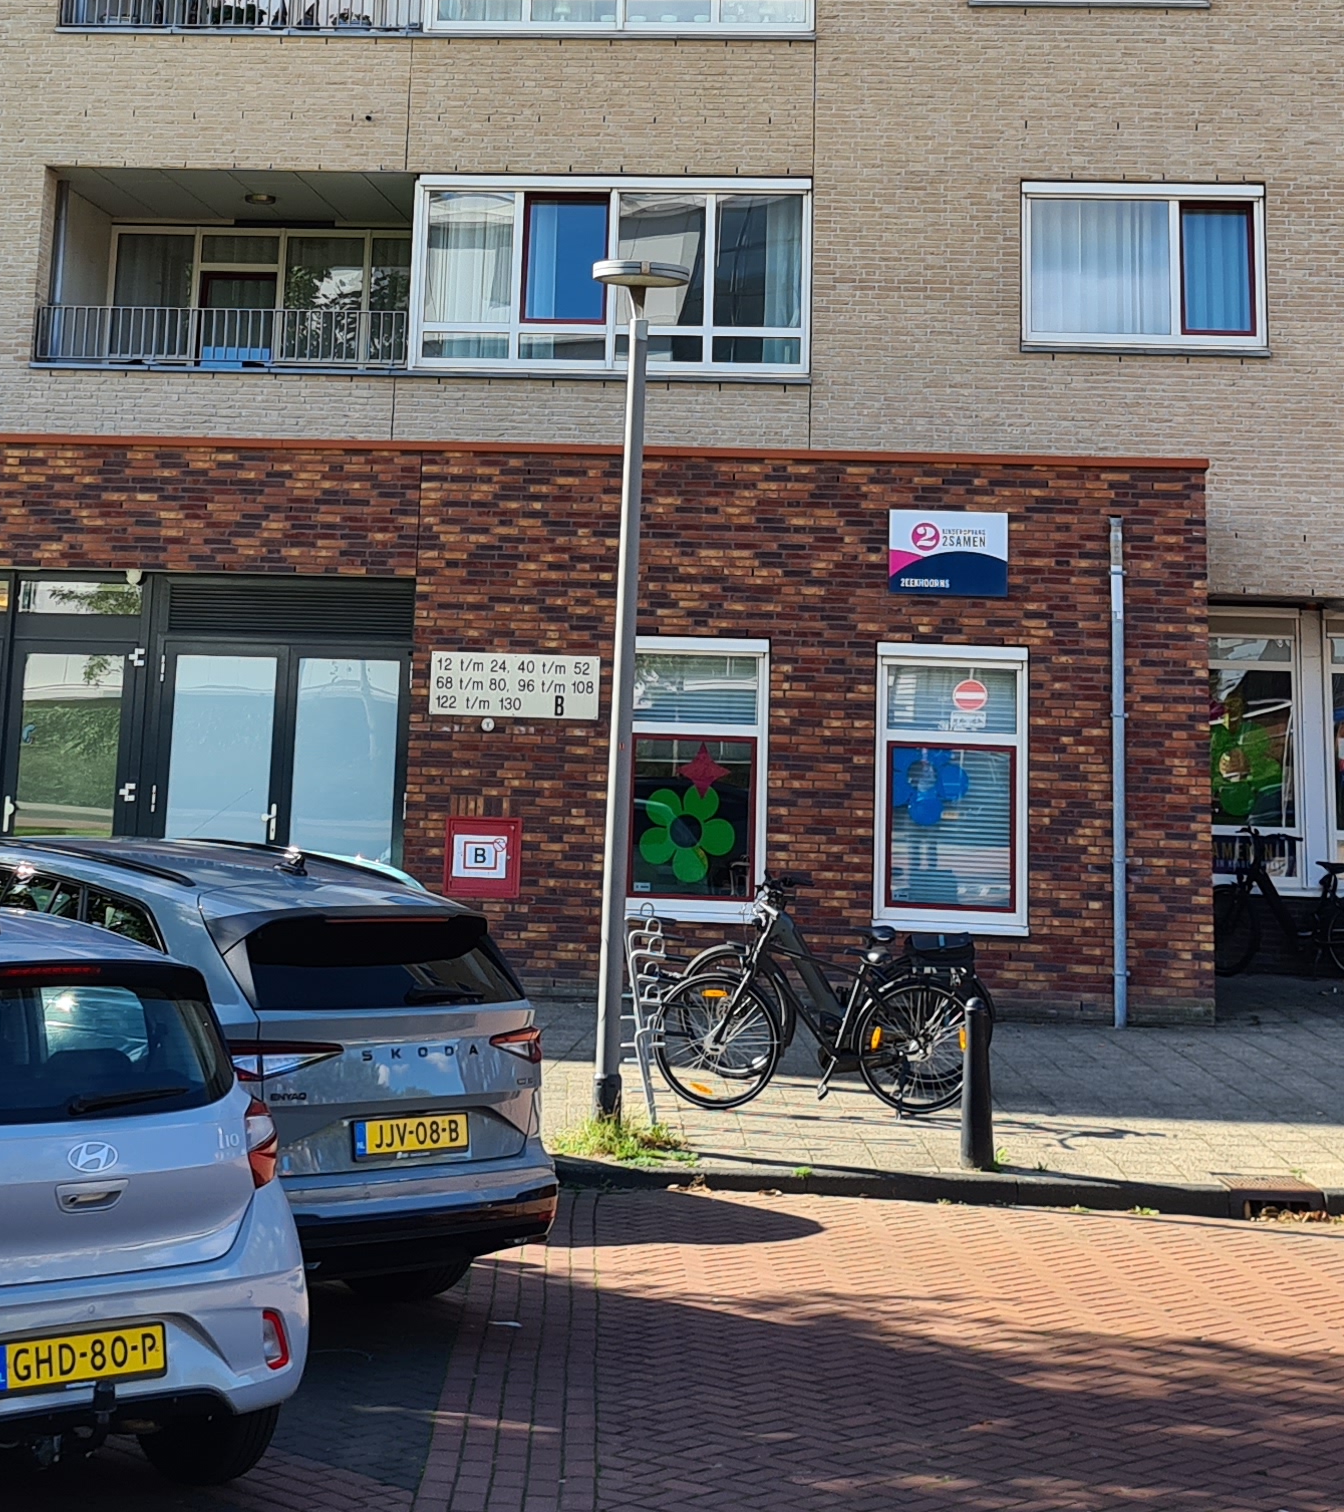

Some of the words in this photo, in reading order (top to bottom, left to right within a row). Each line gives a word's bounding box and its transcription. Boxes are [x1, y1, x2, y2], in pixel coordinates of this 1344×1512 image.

[942, 535, 986, 548] 2SAMEN
[436, 657, 453, 671] 12
[460, 658, 484, 672] t/m
[517, 660, 535, 674] 40
[542, 661, 566, 675] t/m
[573, 662, 590, 676] 52
[436, 676, 453, 690] 68
[459, 677, 484, 691] t/m
[517, 679, 535, 693] 96
[541, 680, 566, 694] t/m
[571, 681, 595, 695] 108
[435, 695, 457, 709] 122
[465, 696, 490, 710] t/m
[498, 697, 522, 711] 130
[554, 695, 565, 717] B
[474, 847, 487, 864] B
[375, 1119, 460, 1149] JJV-08-B
[12, 1332, 157, 1382] GHD-80-P
